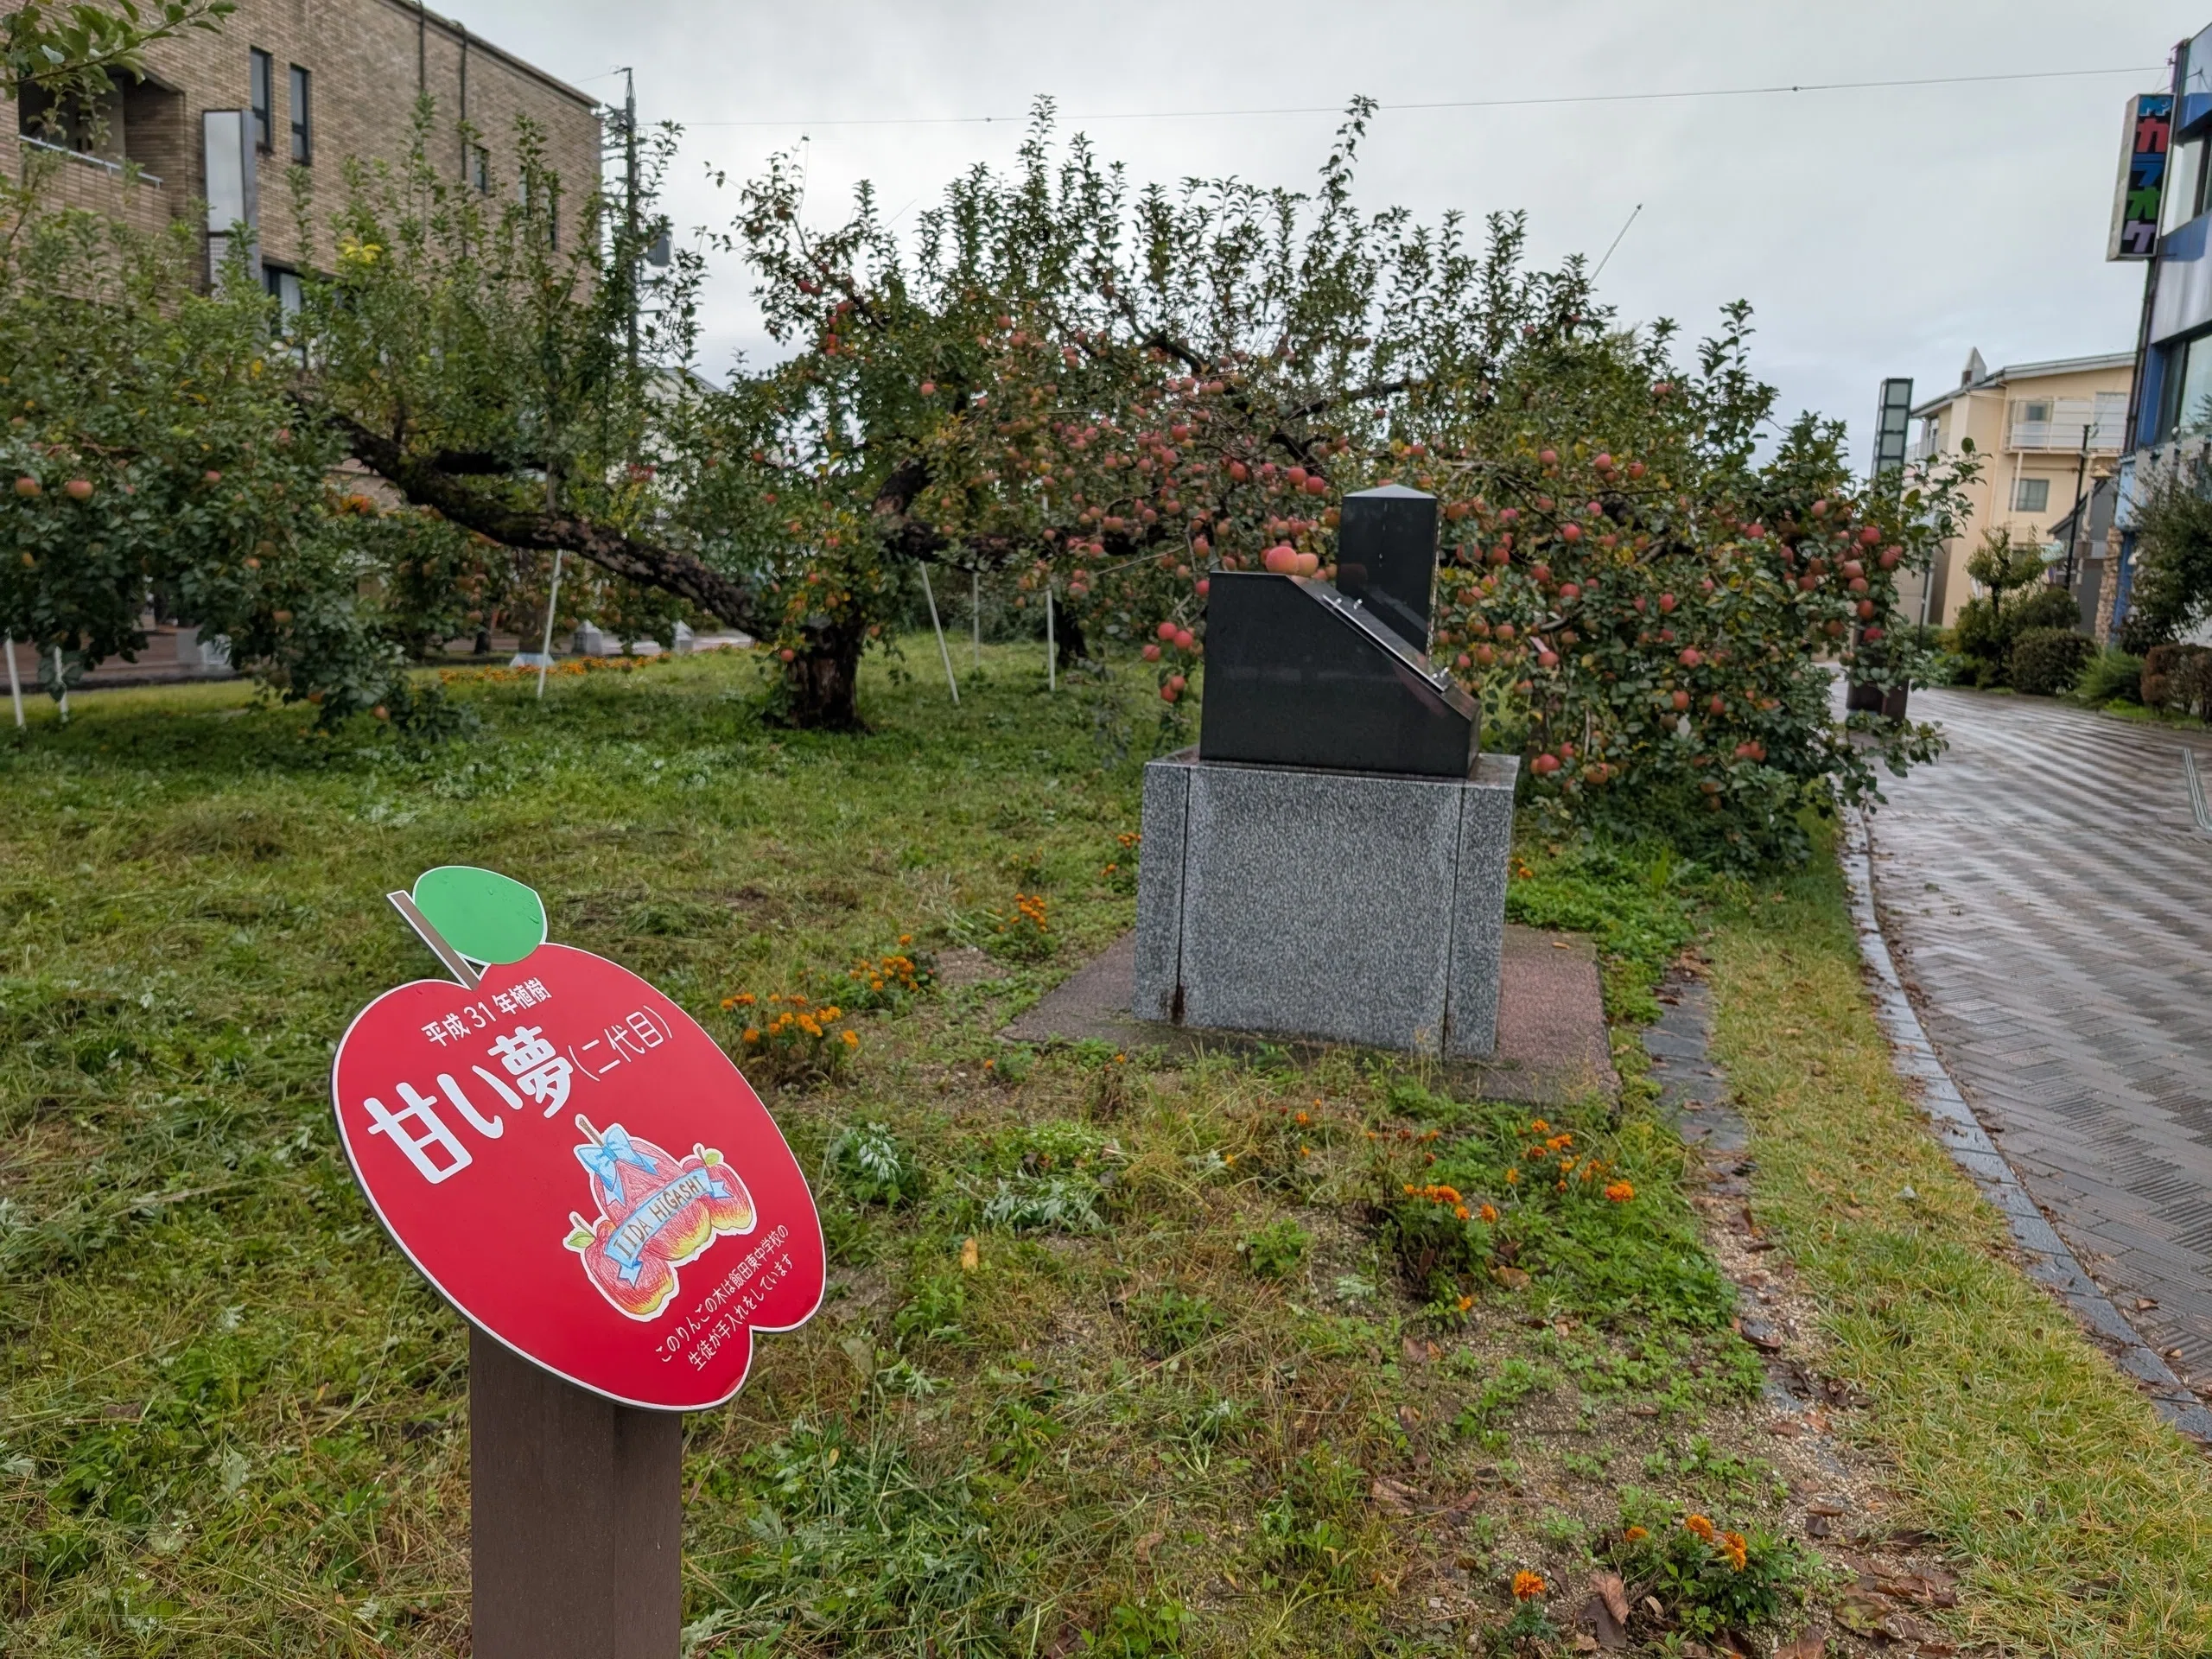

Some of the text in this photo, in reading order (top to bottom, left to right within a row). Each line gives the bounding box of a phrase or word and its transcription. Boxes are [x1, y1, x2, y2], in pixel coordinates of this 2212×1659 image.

[2122, 118, 2170, 253] カラオケ
[363, 1025, 573, 1185] 甘い夢
[613, 1175, 708, 1260] IIDA HIGASHI
[655, 1224, 789, 1363] このりんごの木は飯田東中学校の
[688, 1252, 794, 1371] 生徒が手入れをしています
